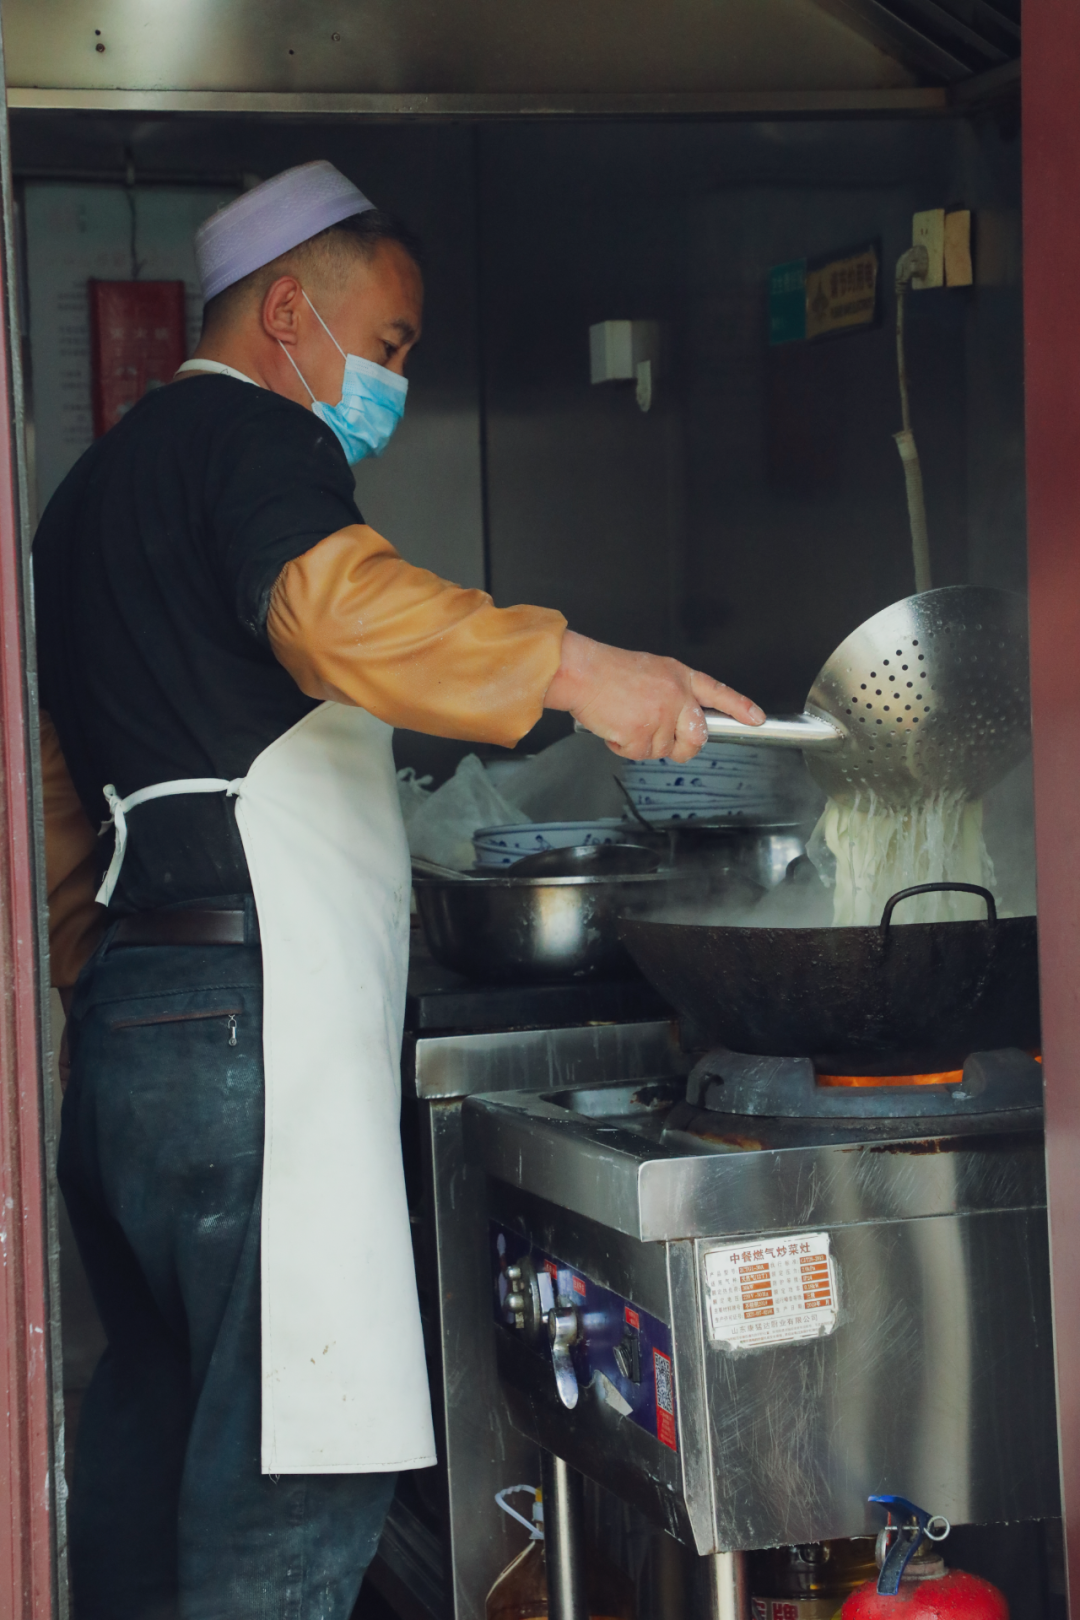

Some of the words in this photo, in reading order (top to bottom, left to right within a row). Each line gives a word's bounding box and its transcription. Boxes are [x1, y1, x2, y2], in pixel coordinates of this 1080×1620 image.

[729, 1242, 812, 1265] 中餐燃气炒菜灶
